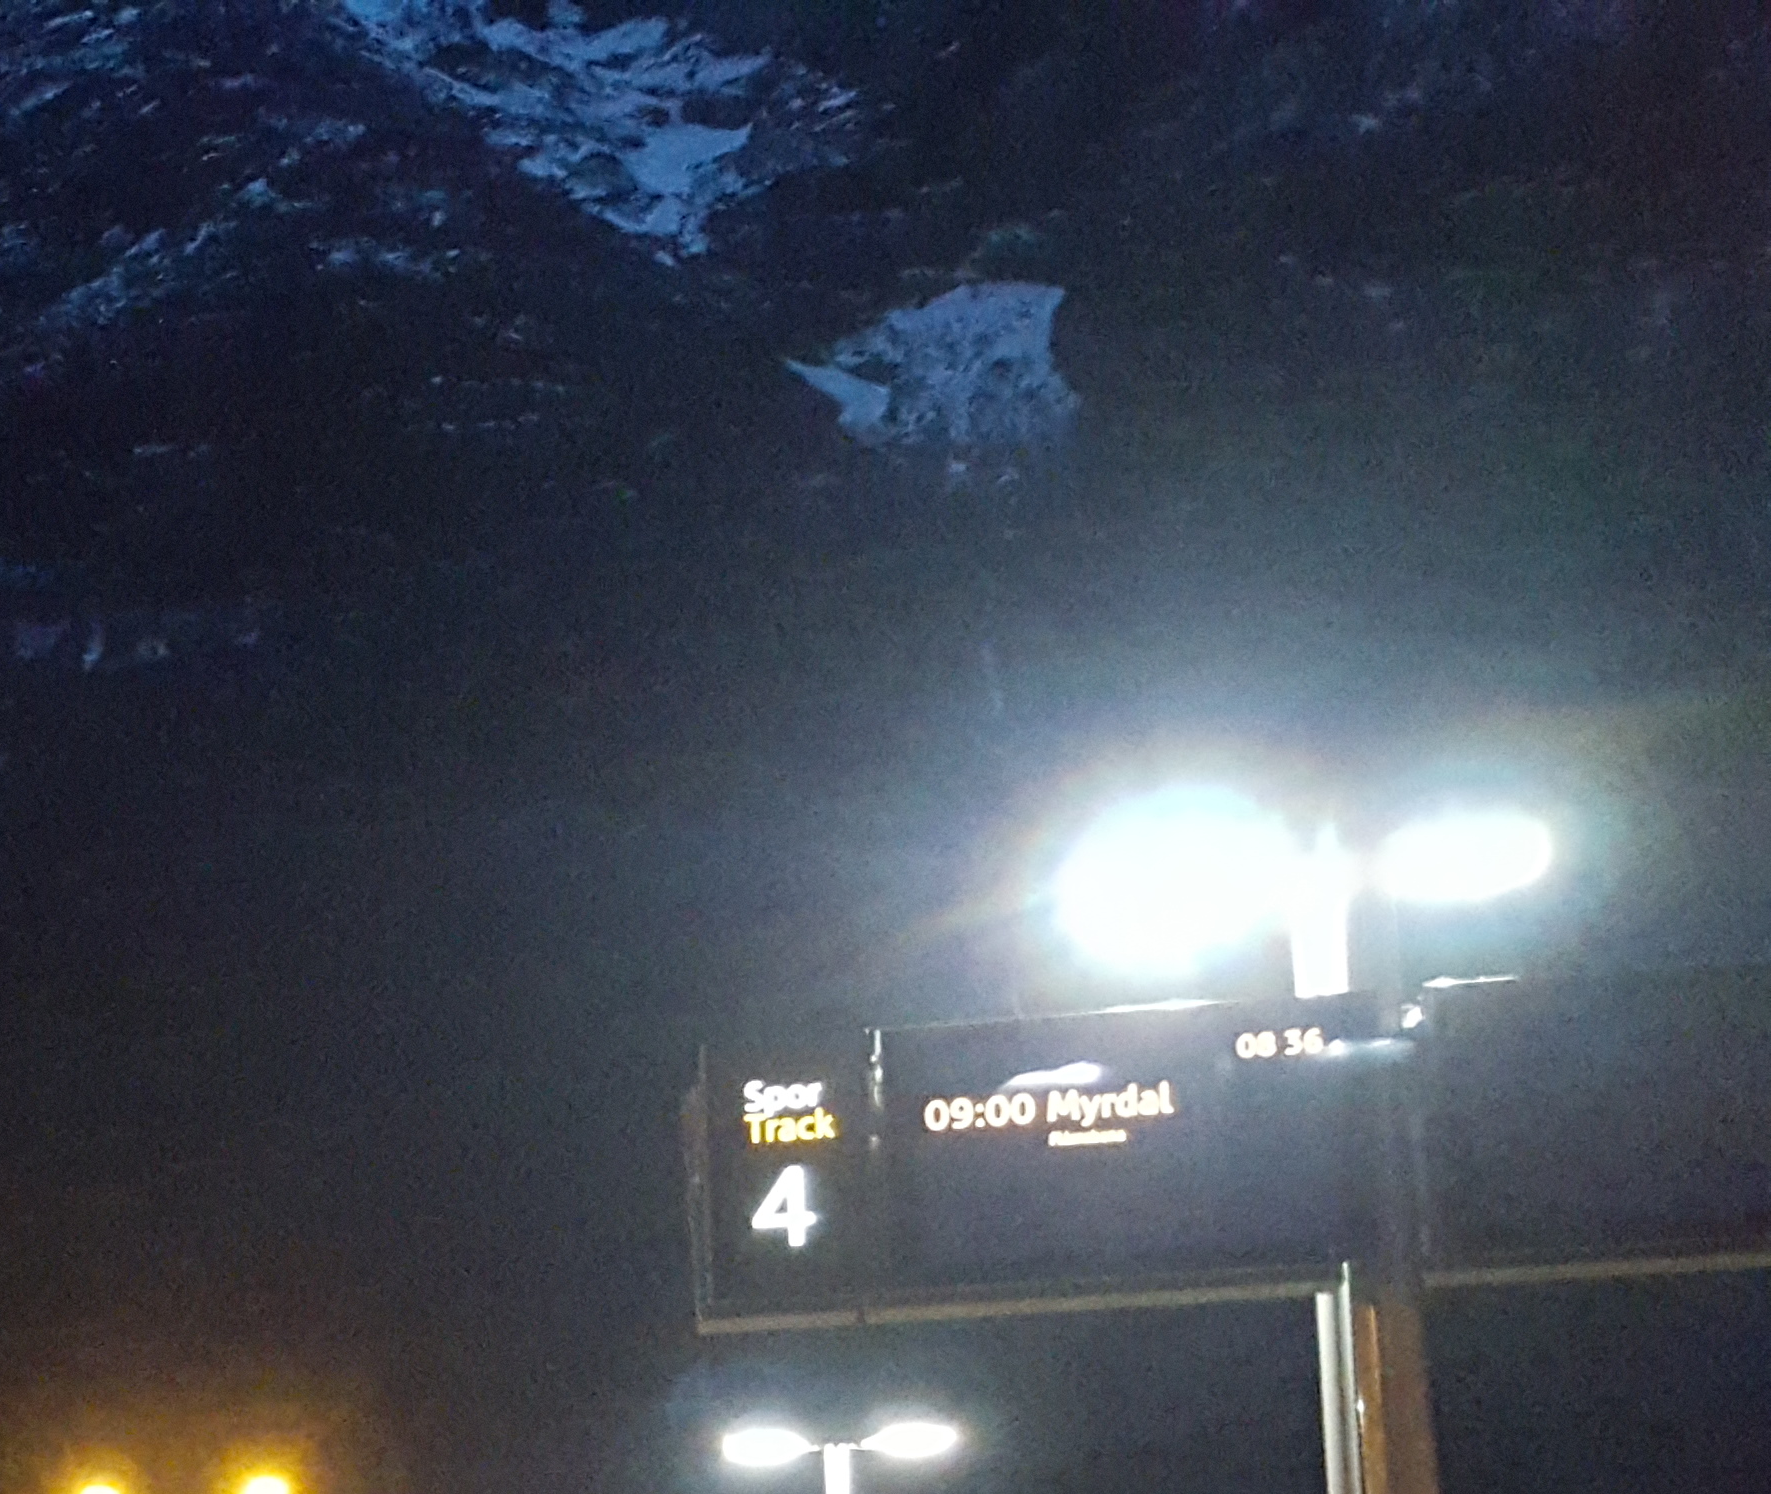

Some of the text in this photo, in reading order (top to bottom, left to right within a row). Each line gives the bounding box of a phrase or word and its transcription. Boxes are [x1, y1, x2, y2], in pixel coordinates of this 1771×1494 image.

[743, 1079, 823, 1118] Spor
[923, 1079, 1176, 1132] 09:00 Myrdal
[743, 1106, 836, 1144] Track
[751, 1164, 819, 1247] 4
